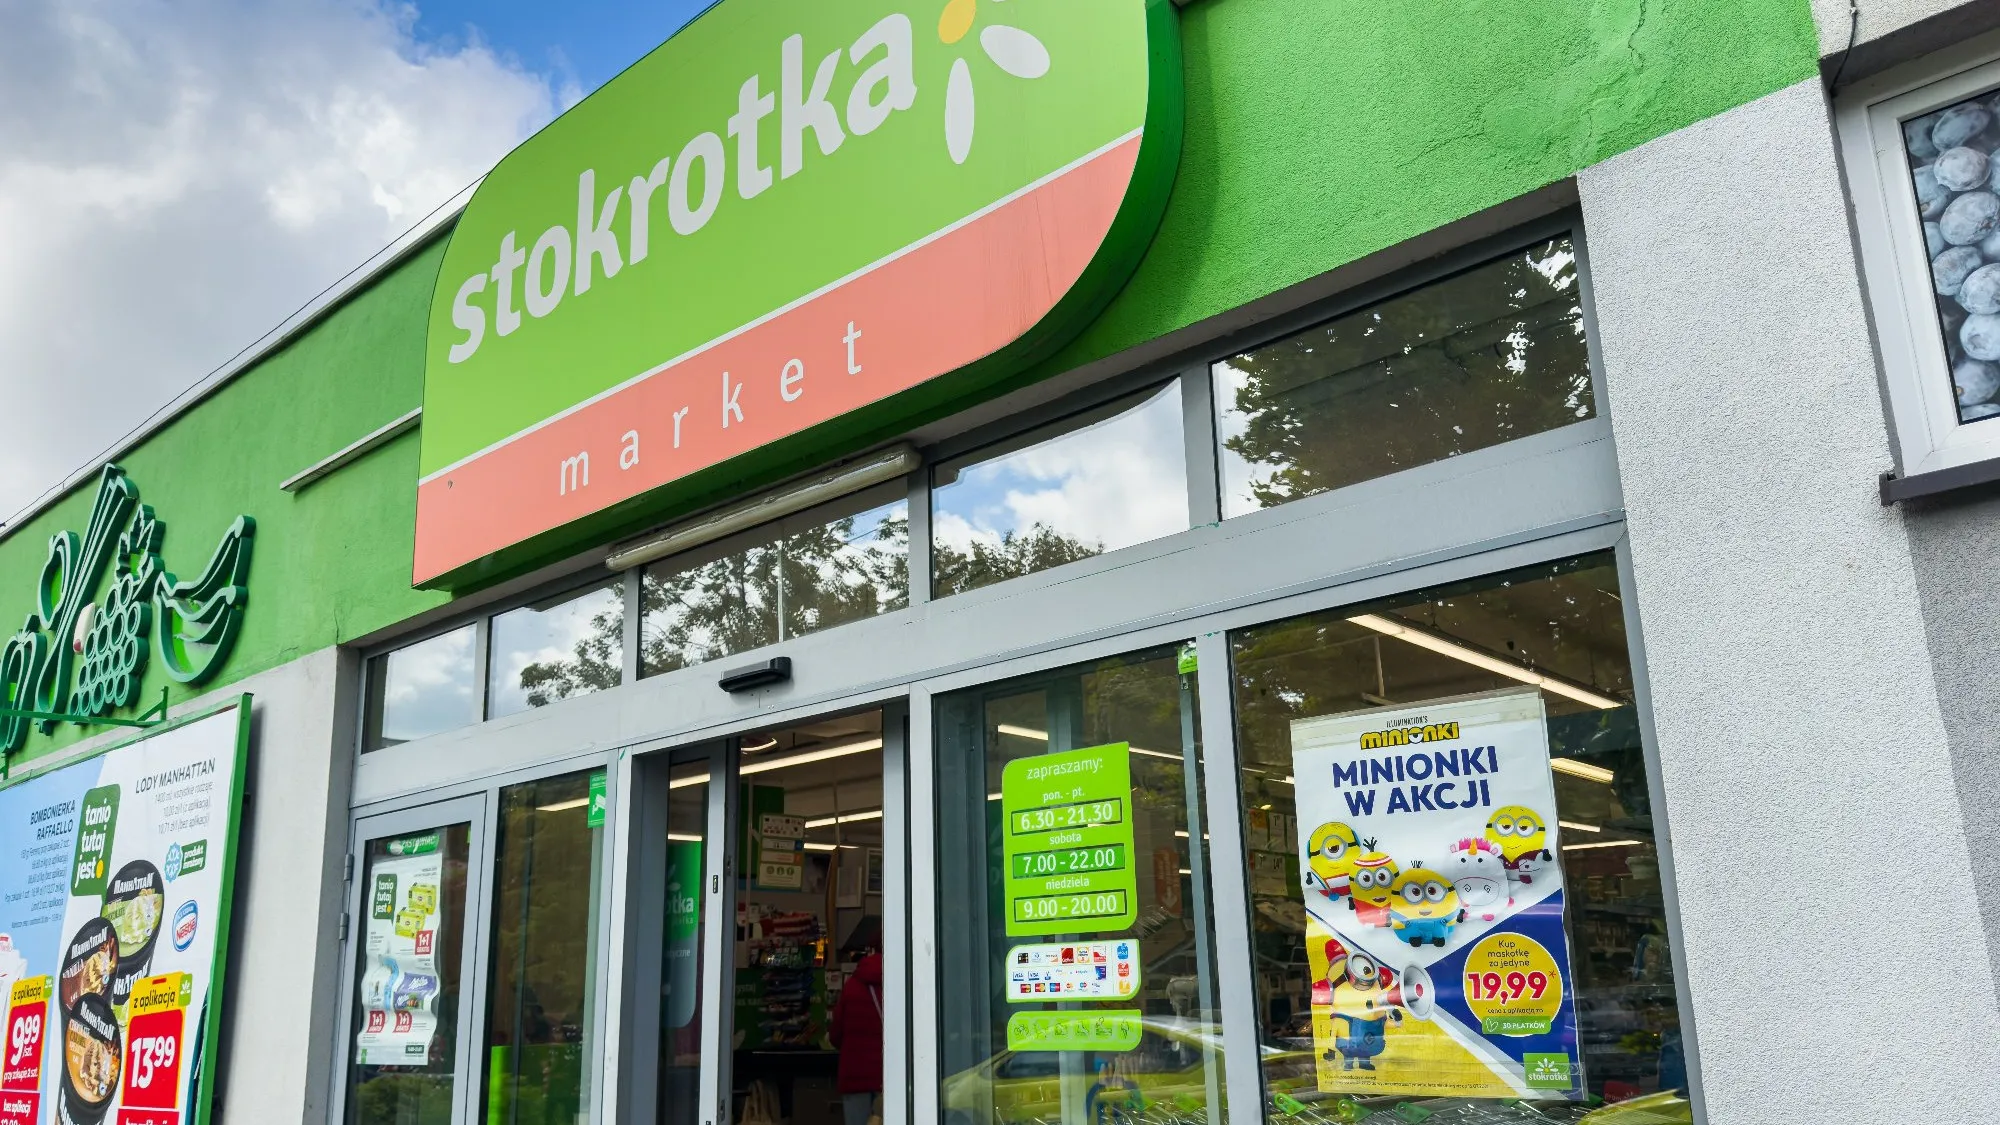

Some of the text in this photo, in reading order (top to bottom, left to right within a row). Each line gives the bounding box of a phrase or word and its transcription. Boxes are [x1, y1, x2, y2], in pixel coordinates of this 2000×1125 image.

[448, 13, 917, 364] stokrotka
[560, 320, 863, 496] market
[1386, 715, 1429, 728] ILLUMINATION'S
[1360, 722, 1460, 750] MINIONKI
[135, 757, 216, 794] LODY MANHATTAN
[1026, 757, 1104, 781] zapraszamy:
[1332, 745, 1499, 789] MINIONKI
[1042, 789, 1064, 803] pon.
[1072, 786, 1085, 801] pt.
[1343, 778, 1491, 817] W AKCJI
[30, 799, 76, 825] BOMBONIERKA
[85, 798, 112, 826] tanio
[1021, 810, 1055, 831] 6.30
[1067, 803, 1113, 825] 21.30
[36, 818, 74, 841] RAFFAELLO
[1049, 832, 1082, 845] sobota
[81, 824, 107, 859] tutaj
[1022, 854, 1057, 874] 7.00
[1069, 848, 1115, 870] 22.00
[113, 872, 155, 895] MANHATTAN
[378, 878, 394, 892] tanio
[1045, 876, 1090, 890] niedziela
[377, 892, 392, 904] tutaj
[1023, 899, 1058, 919] 9.00
[1070, 894, 1117, 915] 20.00
[418, 933, 430, 947] 1+1
[1498, 939, 1516, 949] Kup
[1487, 949, 1530, 958] maskotkę
[1488, 958, 1530, 969] za jedyne
[13, 982, 42, 1003] z aplikacją
[133, 987, 176, 1012] z aplikacją
[1467, 971, 1548, 1005] 19,99
[1512, 1021, 1546, 1029] PŁATKÓW
[1528, 1072, 1568, 1082] stokrotka
